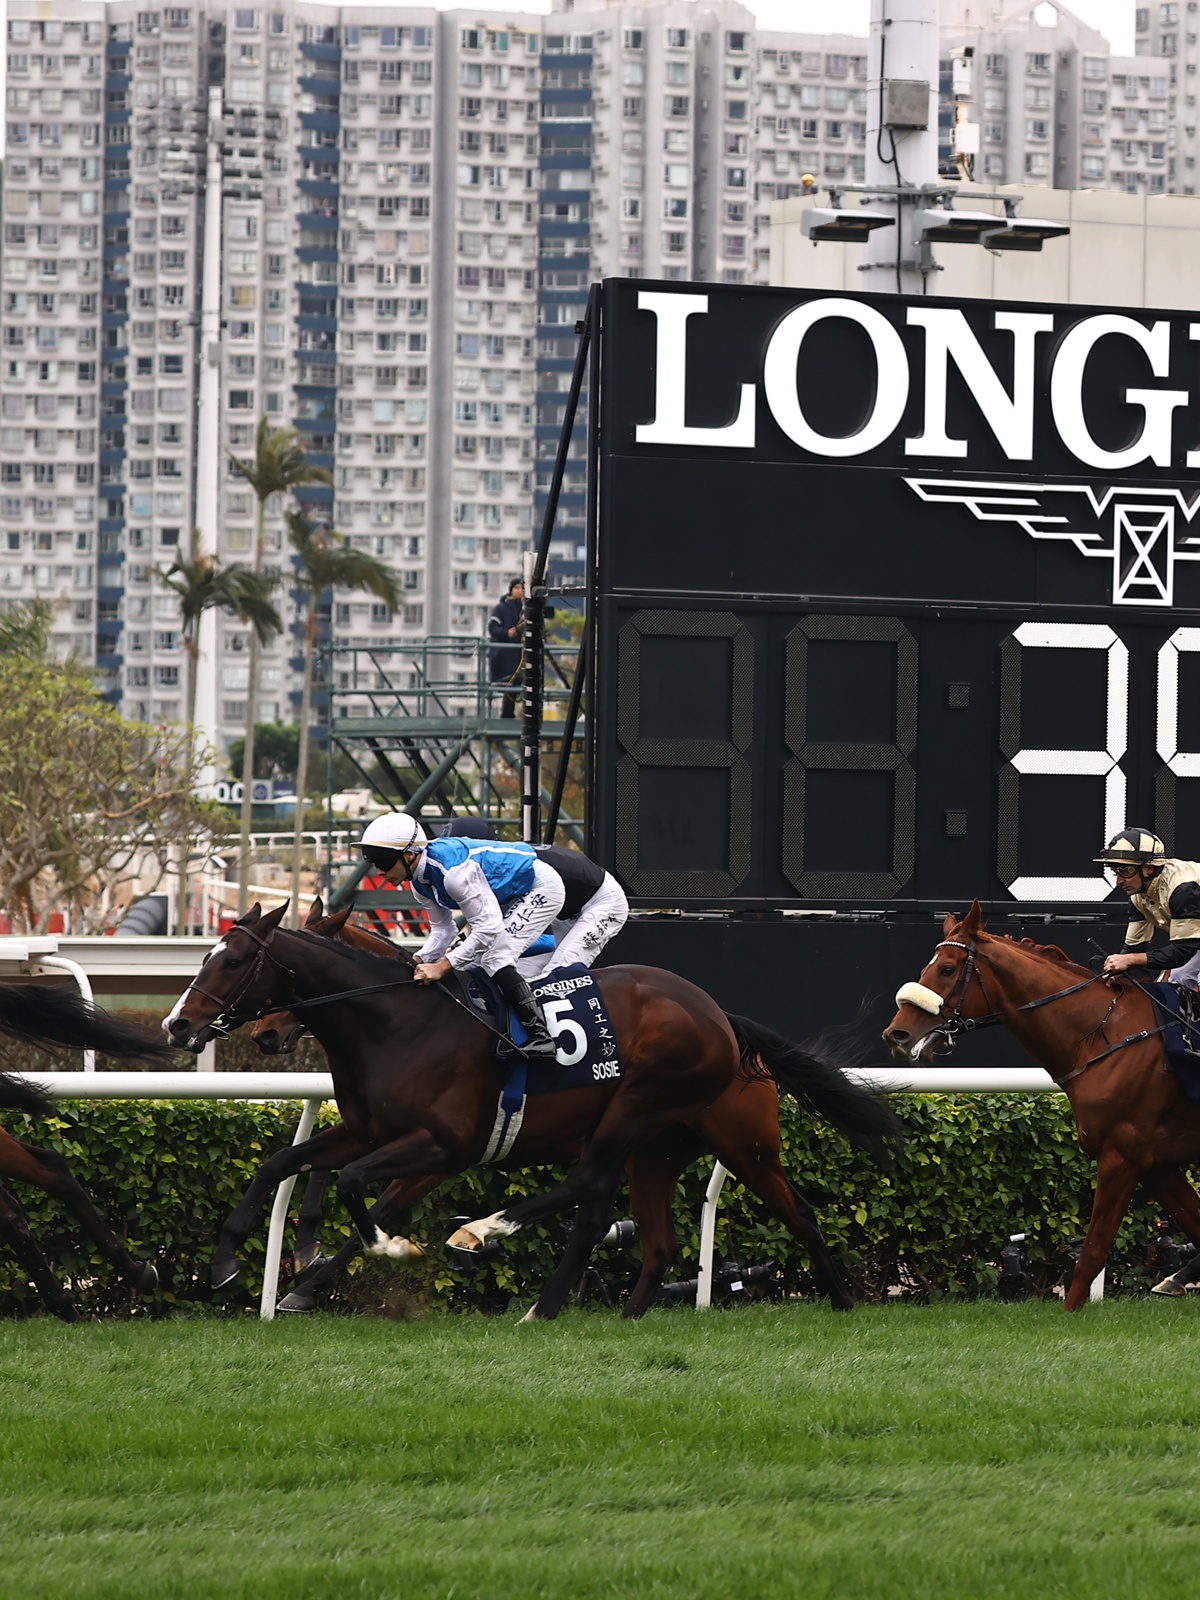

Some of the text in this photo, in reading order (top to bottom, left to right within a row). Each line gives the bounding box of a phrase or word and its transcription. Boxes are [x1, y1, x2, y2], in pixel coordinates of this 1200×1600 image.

[533, 975, 593, 998] ONGINES
[542, 999, 588, 1067] 5
[587, 997, 617, 1057] 同工之妙
[592, 1060, 621, 1080] SOSIE
